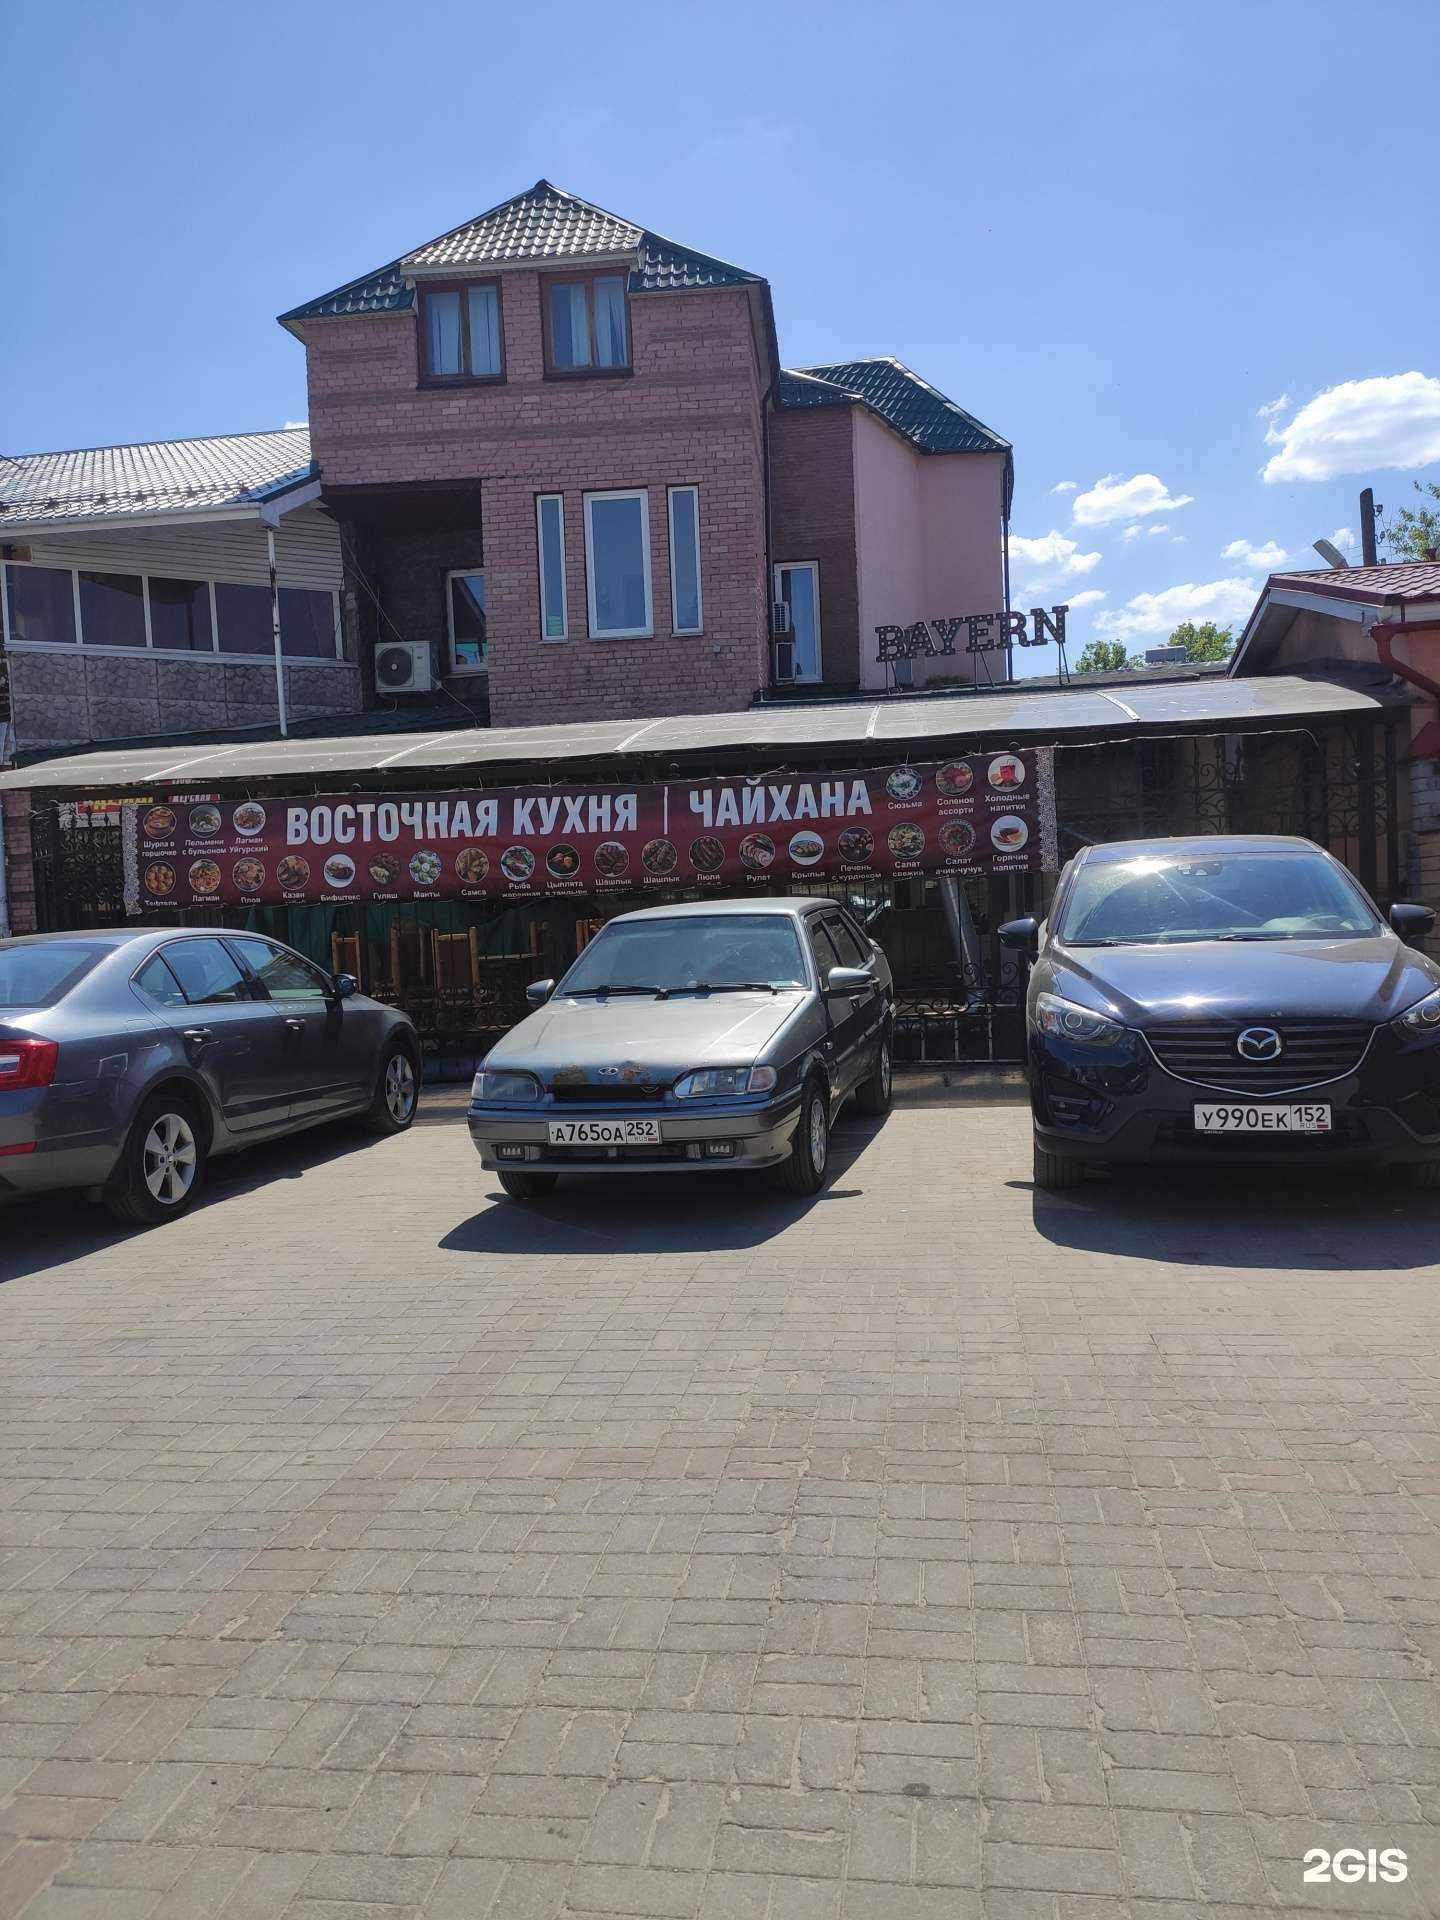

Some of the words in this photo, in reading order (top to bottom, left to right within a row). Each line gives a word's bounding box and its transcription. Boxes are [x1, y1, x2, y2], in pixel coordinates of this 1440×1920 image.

[875, 605, 1069, 662] BAYERN
[689, 776, 873, 828] ЧАЙХАНА
[984, 793, 1030, 802] Холодные
[887, 800, 923, 810] Сюзьма
[990, 803, 1026, 812] напитки
[938, 807, 974, 816] ассорти
[286, 799, 499, 846] ВОСТОЧНАЯ
[512, 793, 638, 836] КУХНЯ
[143, 840, 168, 849] Шурпа
[185, 839, 224, 847] Пельмени
[235, 836, 263, 845] Лагман
[189, 847, 227, 856] бульоном
[229, 845, 269, 854] Уйгурский
[945, 857, 973, 865] Салат
[992, 853, 1029, 863] Горячие
[840, 864, 872, 872] Печень
[894, 860, 921, 869] Салат
[992, 863, 1029, 872] напитки
[791, 870, 826, 880] Крылья
[892, 869, 924, 877] свежий
[935, 866, 983, 876] ачик-чучук
[595, 878, 632, 886] Шашлык
[643, 876, 680, 884] Шашлык
[746, 874, 771, 882] Рулет
[508, 882, 531, 890] Рыба
[546, 881, 584, 889] Цыплята
[282, 890, 305, 898] Казан
[373, 891, 398, 900] Гуляш
[413, 890, 440, 898] Манты
[461, 888, 487, 896] Самса
[192, 894, 220, 902] Лагман
[320, 894, 361, 902] Бифштекс
[1293, 1107, 1326, 1123] 152
[626, 1122, 655, 1136] 252
